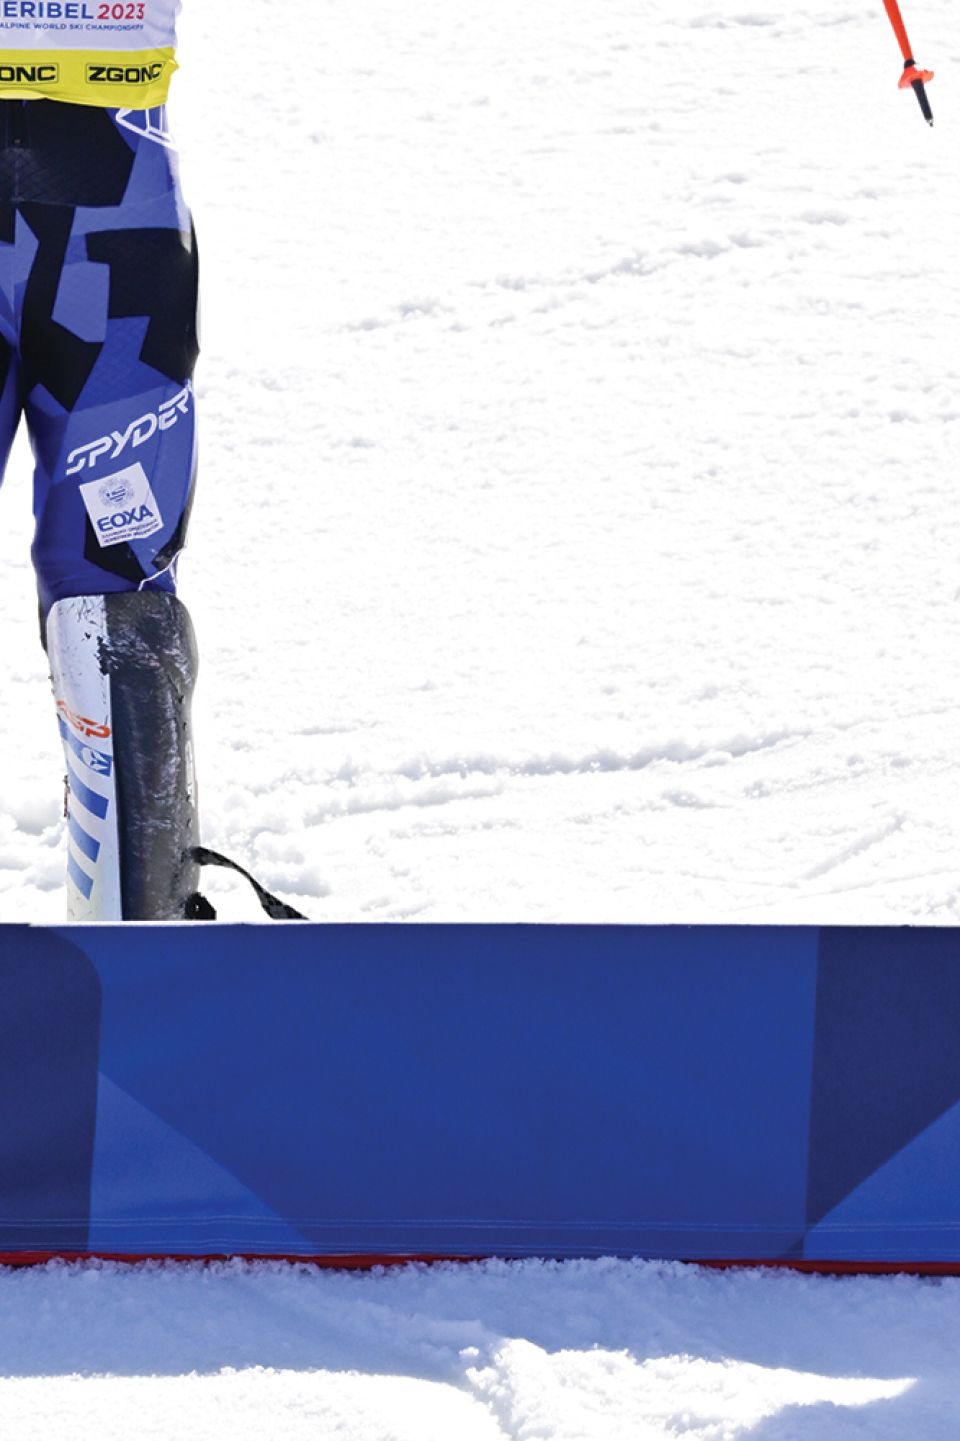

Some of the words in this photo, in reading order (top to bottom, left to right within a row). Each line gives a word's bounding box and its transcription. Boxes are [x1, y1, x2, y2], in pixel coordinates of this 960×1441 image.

[97, 3, 146, 20] 2023
[0, 22, 31, 30] ALPINE
[88, 63, 162, 83] ZGONC
[66, 386, 189, 476] SPYDER
